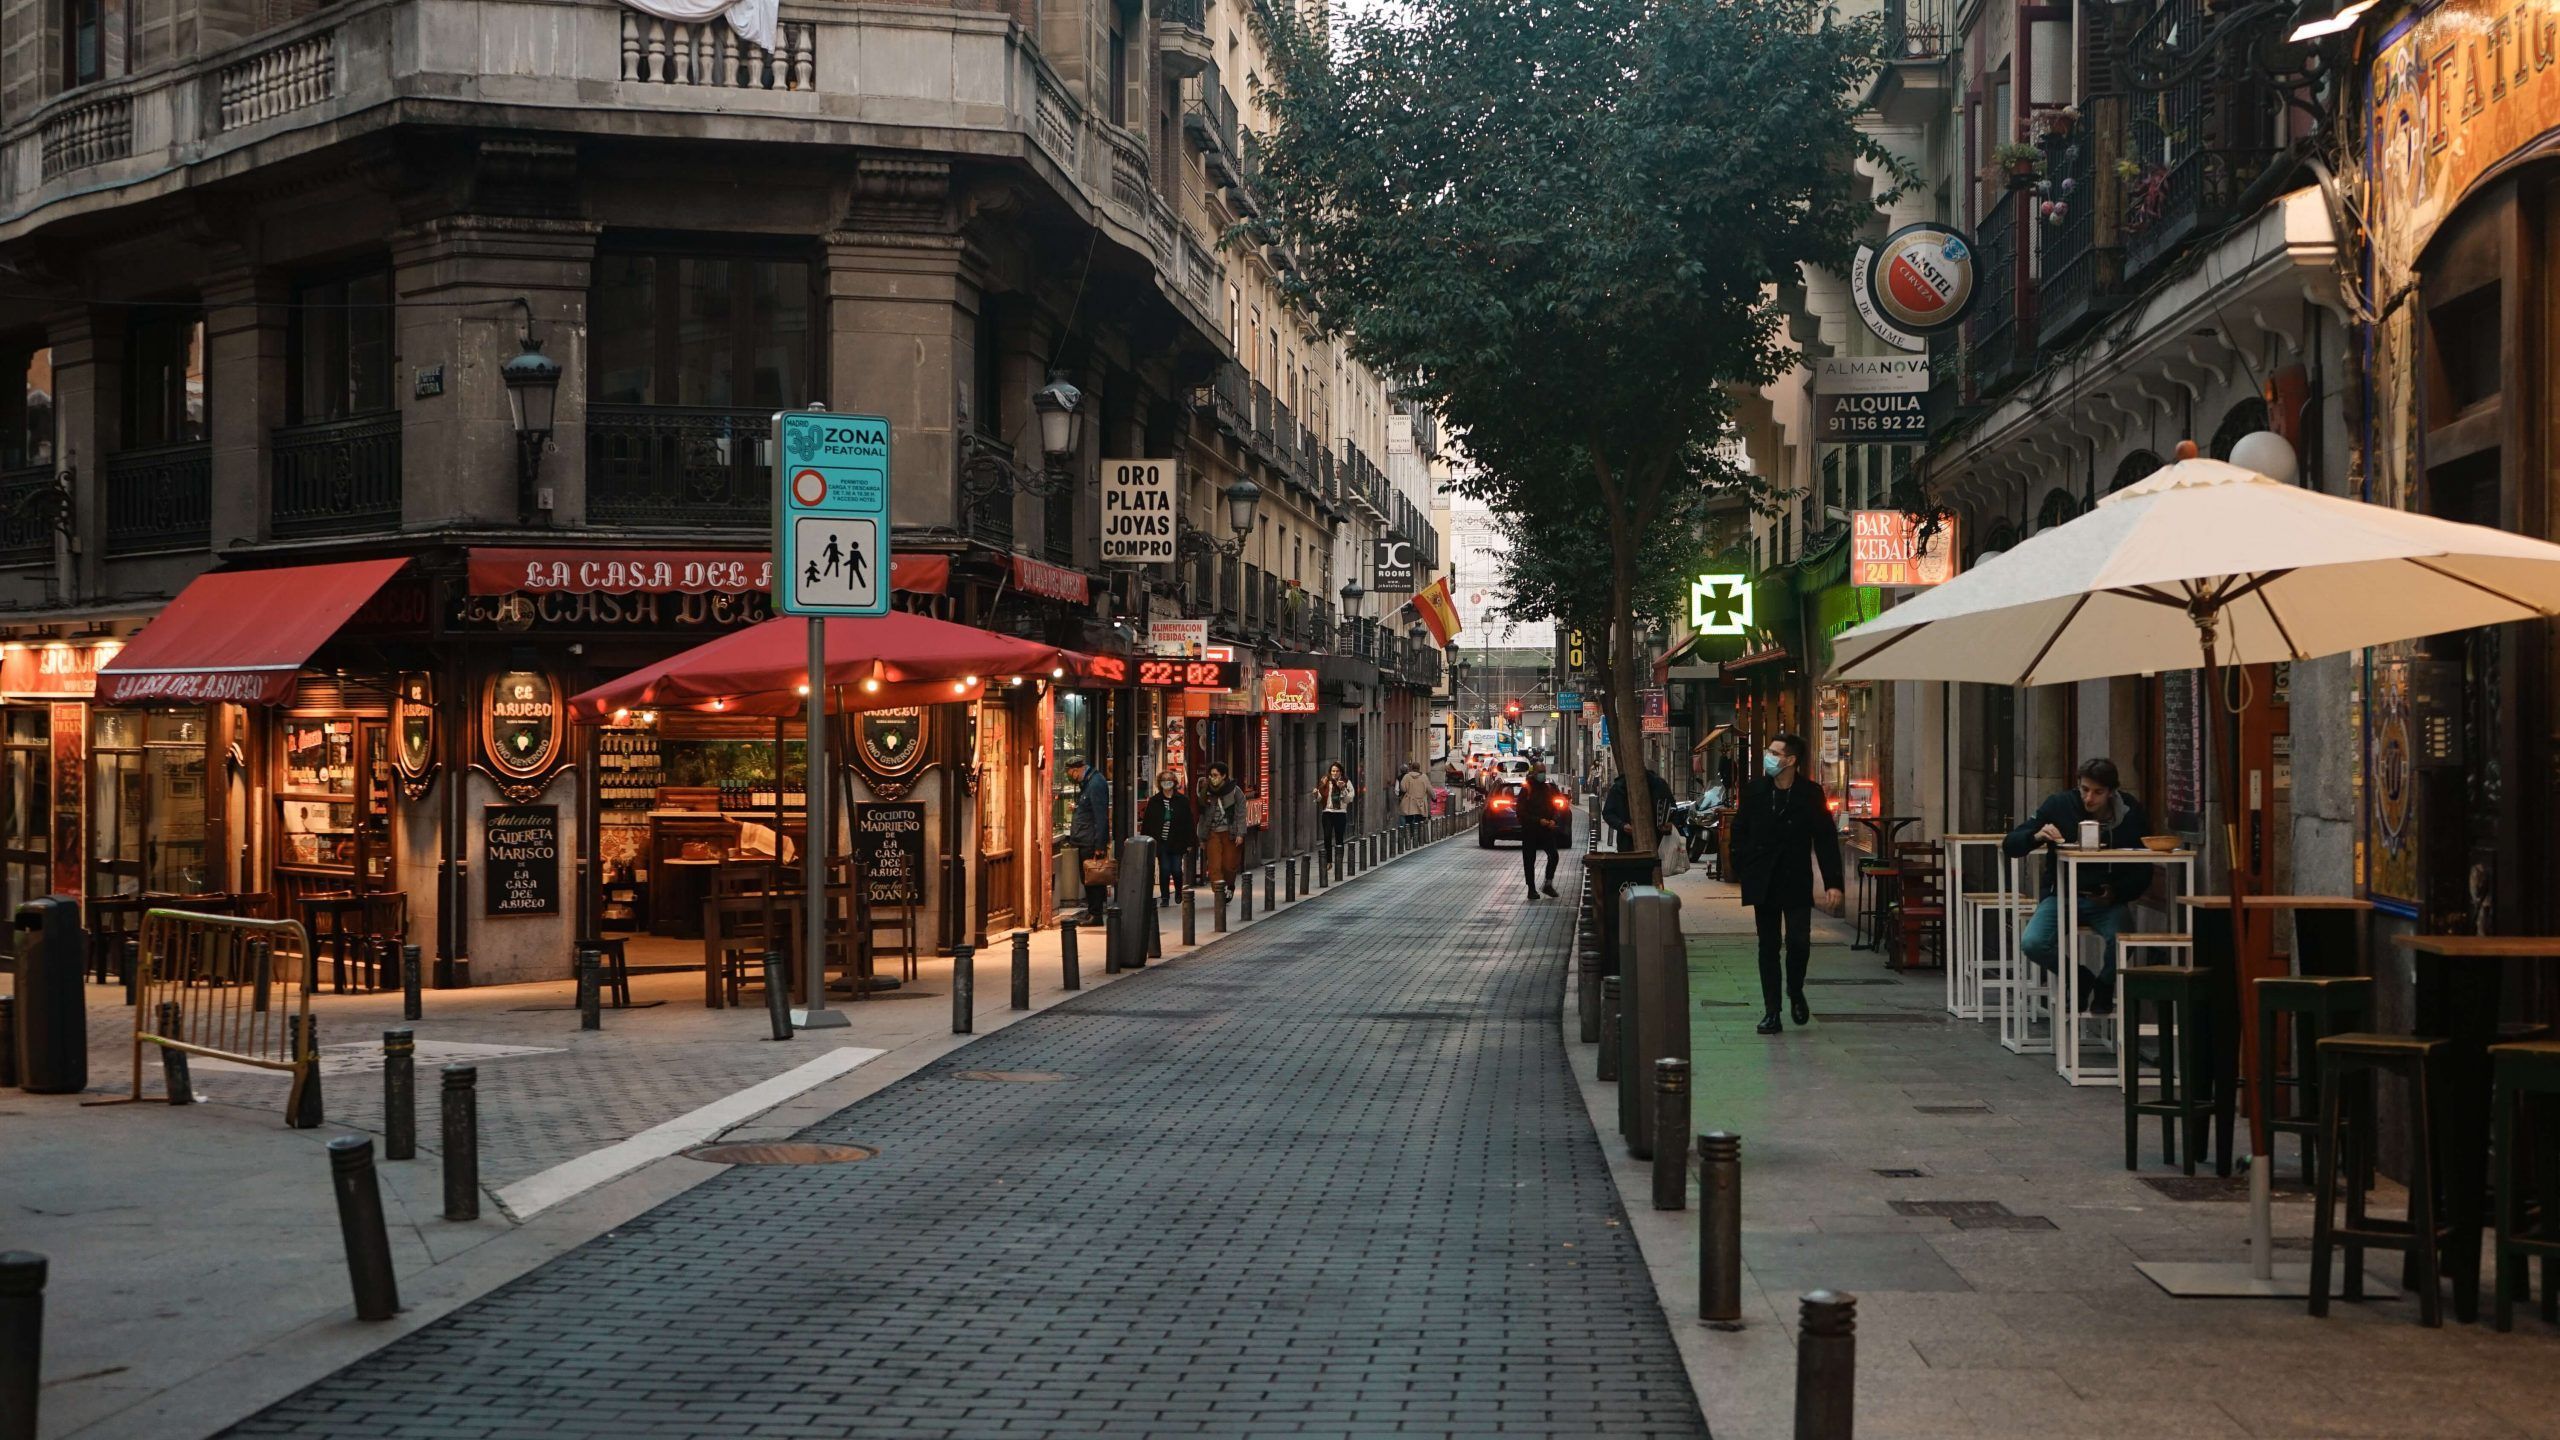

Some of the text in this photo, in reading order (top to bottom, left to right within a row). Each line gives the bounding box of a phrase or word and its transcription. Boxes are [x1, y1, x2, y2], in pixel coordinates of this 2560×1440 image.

[1907, 250, 1951, 297] AMSTEL
[1900, 266, 1933, 303] CERVEZA
[1854, 258, 1905, 346] TASCA DE JAIME
[1825, 361, 1929, 375] ALMANOVA
[1835, 396, 1920, 414] ALQUILA
[786, 420, 809, 428] MADRID
[1829, 415, 1926, 430] 91 156 92 22
[825, 428, 886, 445] ZONA
[825, 445, 886, 457] PEATONAL
[1118, 466, 1159, 485] ORO
[1107, 491, 1170, 510] PLATA
[1106, 516, 1170, 535] JOYAS
[1856, 514, 1892, 536] BAR
[1103, 540, 1172, 556] COMPRO
[1379, 542, 1411, 569] JC
[1856, 538, 1916, 560] KEBAB
[524, 561, 571, 588] LA
[579, 561, 673, 588] CASA
[680, 561, 748, 588] DEL
[1866, 563, 1904, 582] 24 H
[537, 592, 660, 622] CASA
[1152, 633, 1186, 642] Y BEBIDAS
[1140, 662, 1220, 685] 22:02
[168, 675, 203, 698] DEL
[203, 674, 263, 700] ABUELO
[493, 702, 552, 717] ABUELO
[496, 739, 549, 766] VINO GENEROSO
[867, 738, 917, 765] VINO GENEROSO
[867, 809, 915, 821] COCIDITO
[489, 828, 553, 845] CALDERETA
[883, 840, 898, 849] LA
[490, 846, 554, 860] MARISCO
[880, 858, 901, 868] DEL
[514, 870, 530, 880] LA
[505, 880, 538, 889] CASA
[510, 890, 534, 899] DEL
[498, 898, 546, 909] ABUELO
